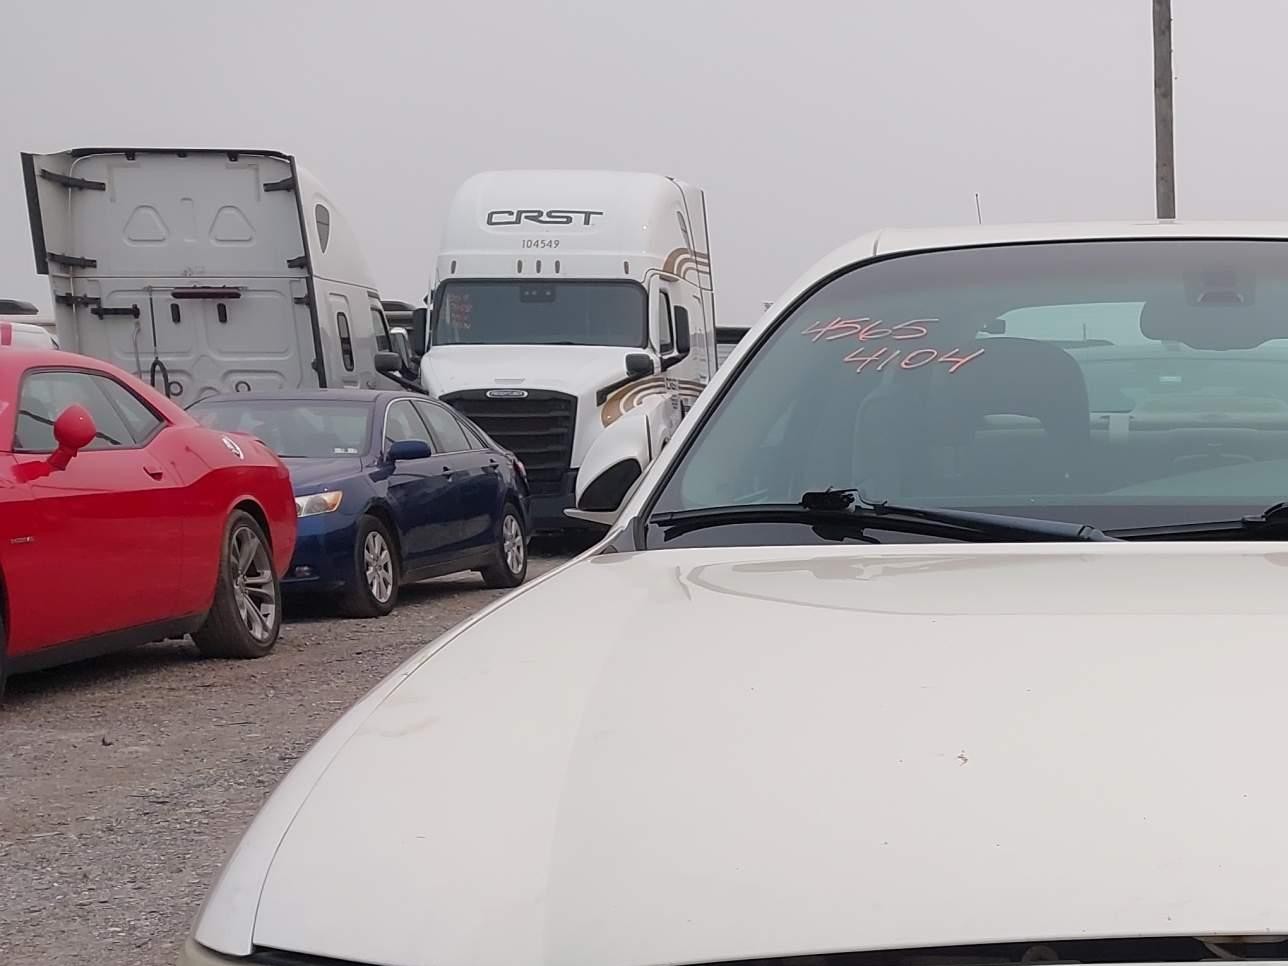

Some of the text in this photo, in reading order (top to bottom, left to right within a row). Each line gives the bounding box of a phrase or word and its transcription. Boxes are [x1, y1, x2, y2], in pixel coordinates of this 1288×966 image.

[486, 209, 604, 226] CRST
[521, 239, 561, 249] 104549
[800, 316, 940, 342] 4565
[843, 347, 986, 373] 4104
